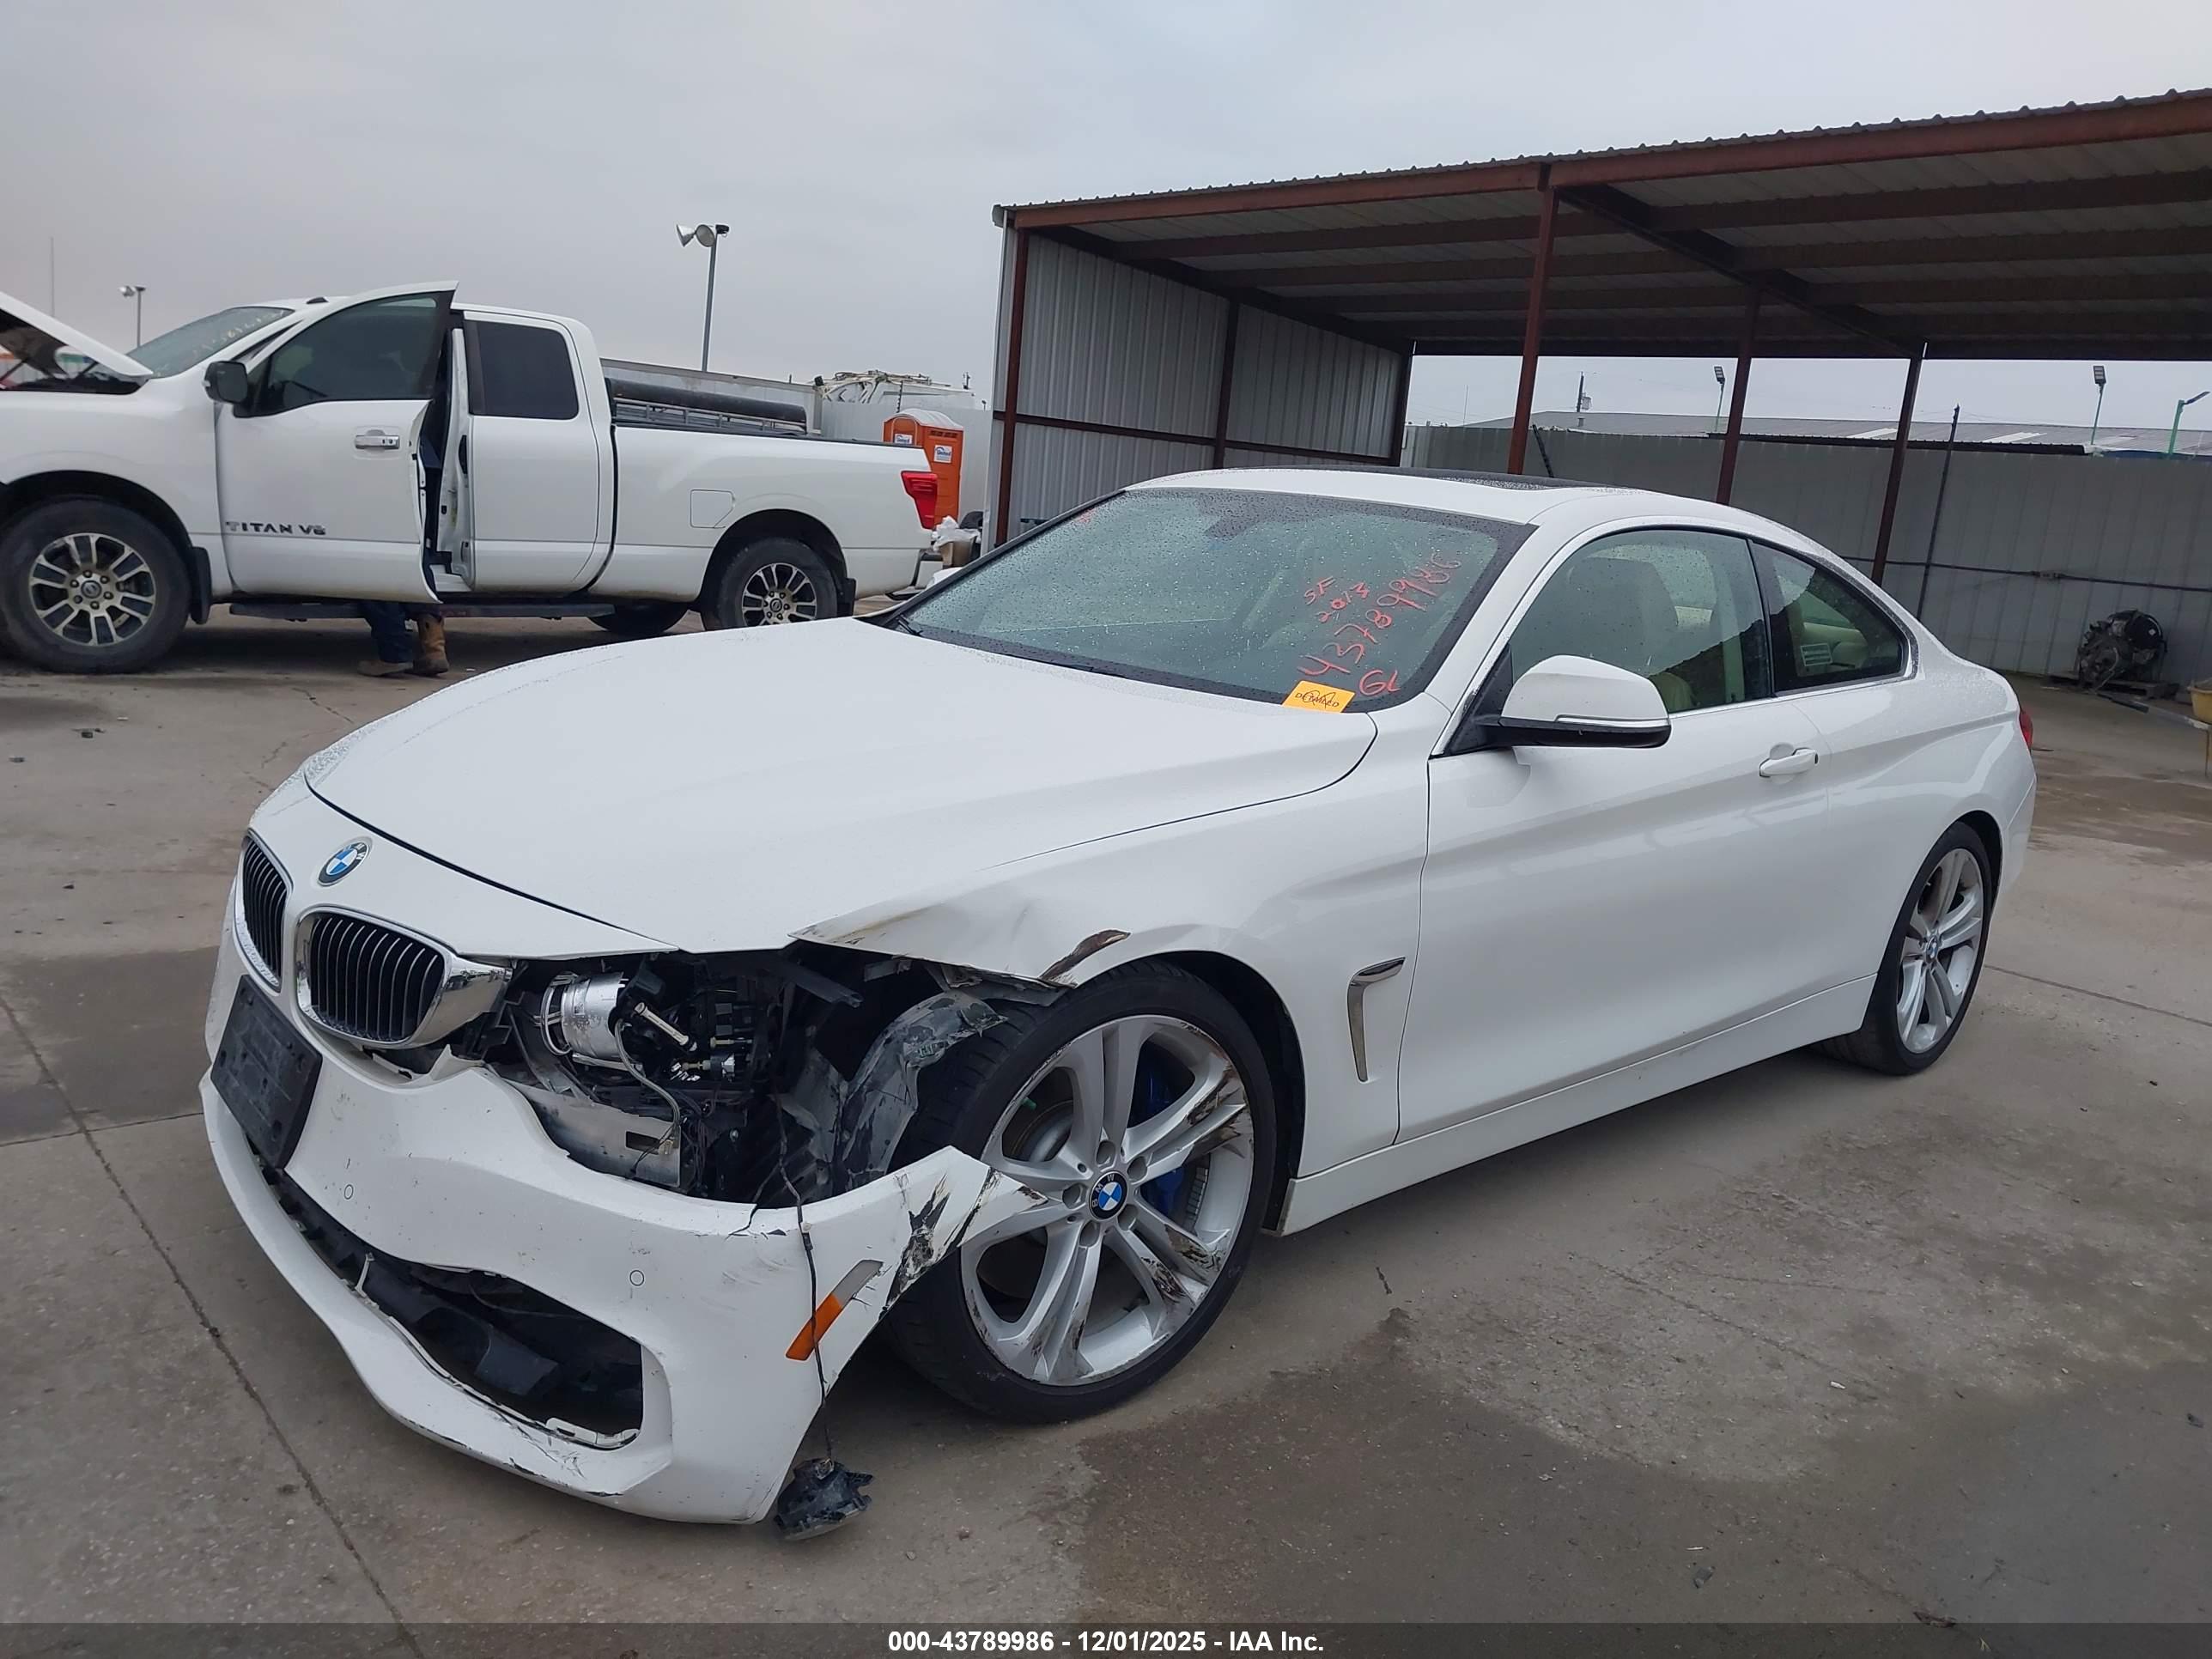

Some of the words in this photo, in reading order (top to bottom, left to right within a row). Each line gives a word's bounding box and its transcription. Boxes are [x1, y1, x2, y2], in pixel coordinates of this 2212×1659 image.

[226, 521, 293, 534] TITAN
[298, 524, 325, 535] V8
[1091, 1173, 1115, 1208] BMW
